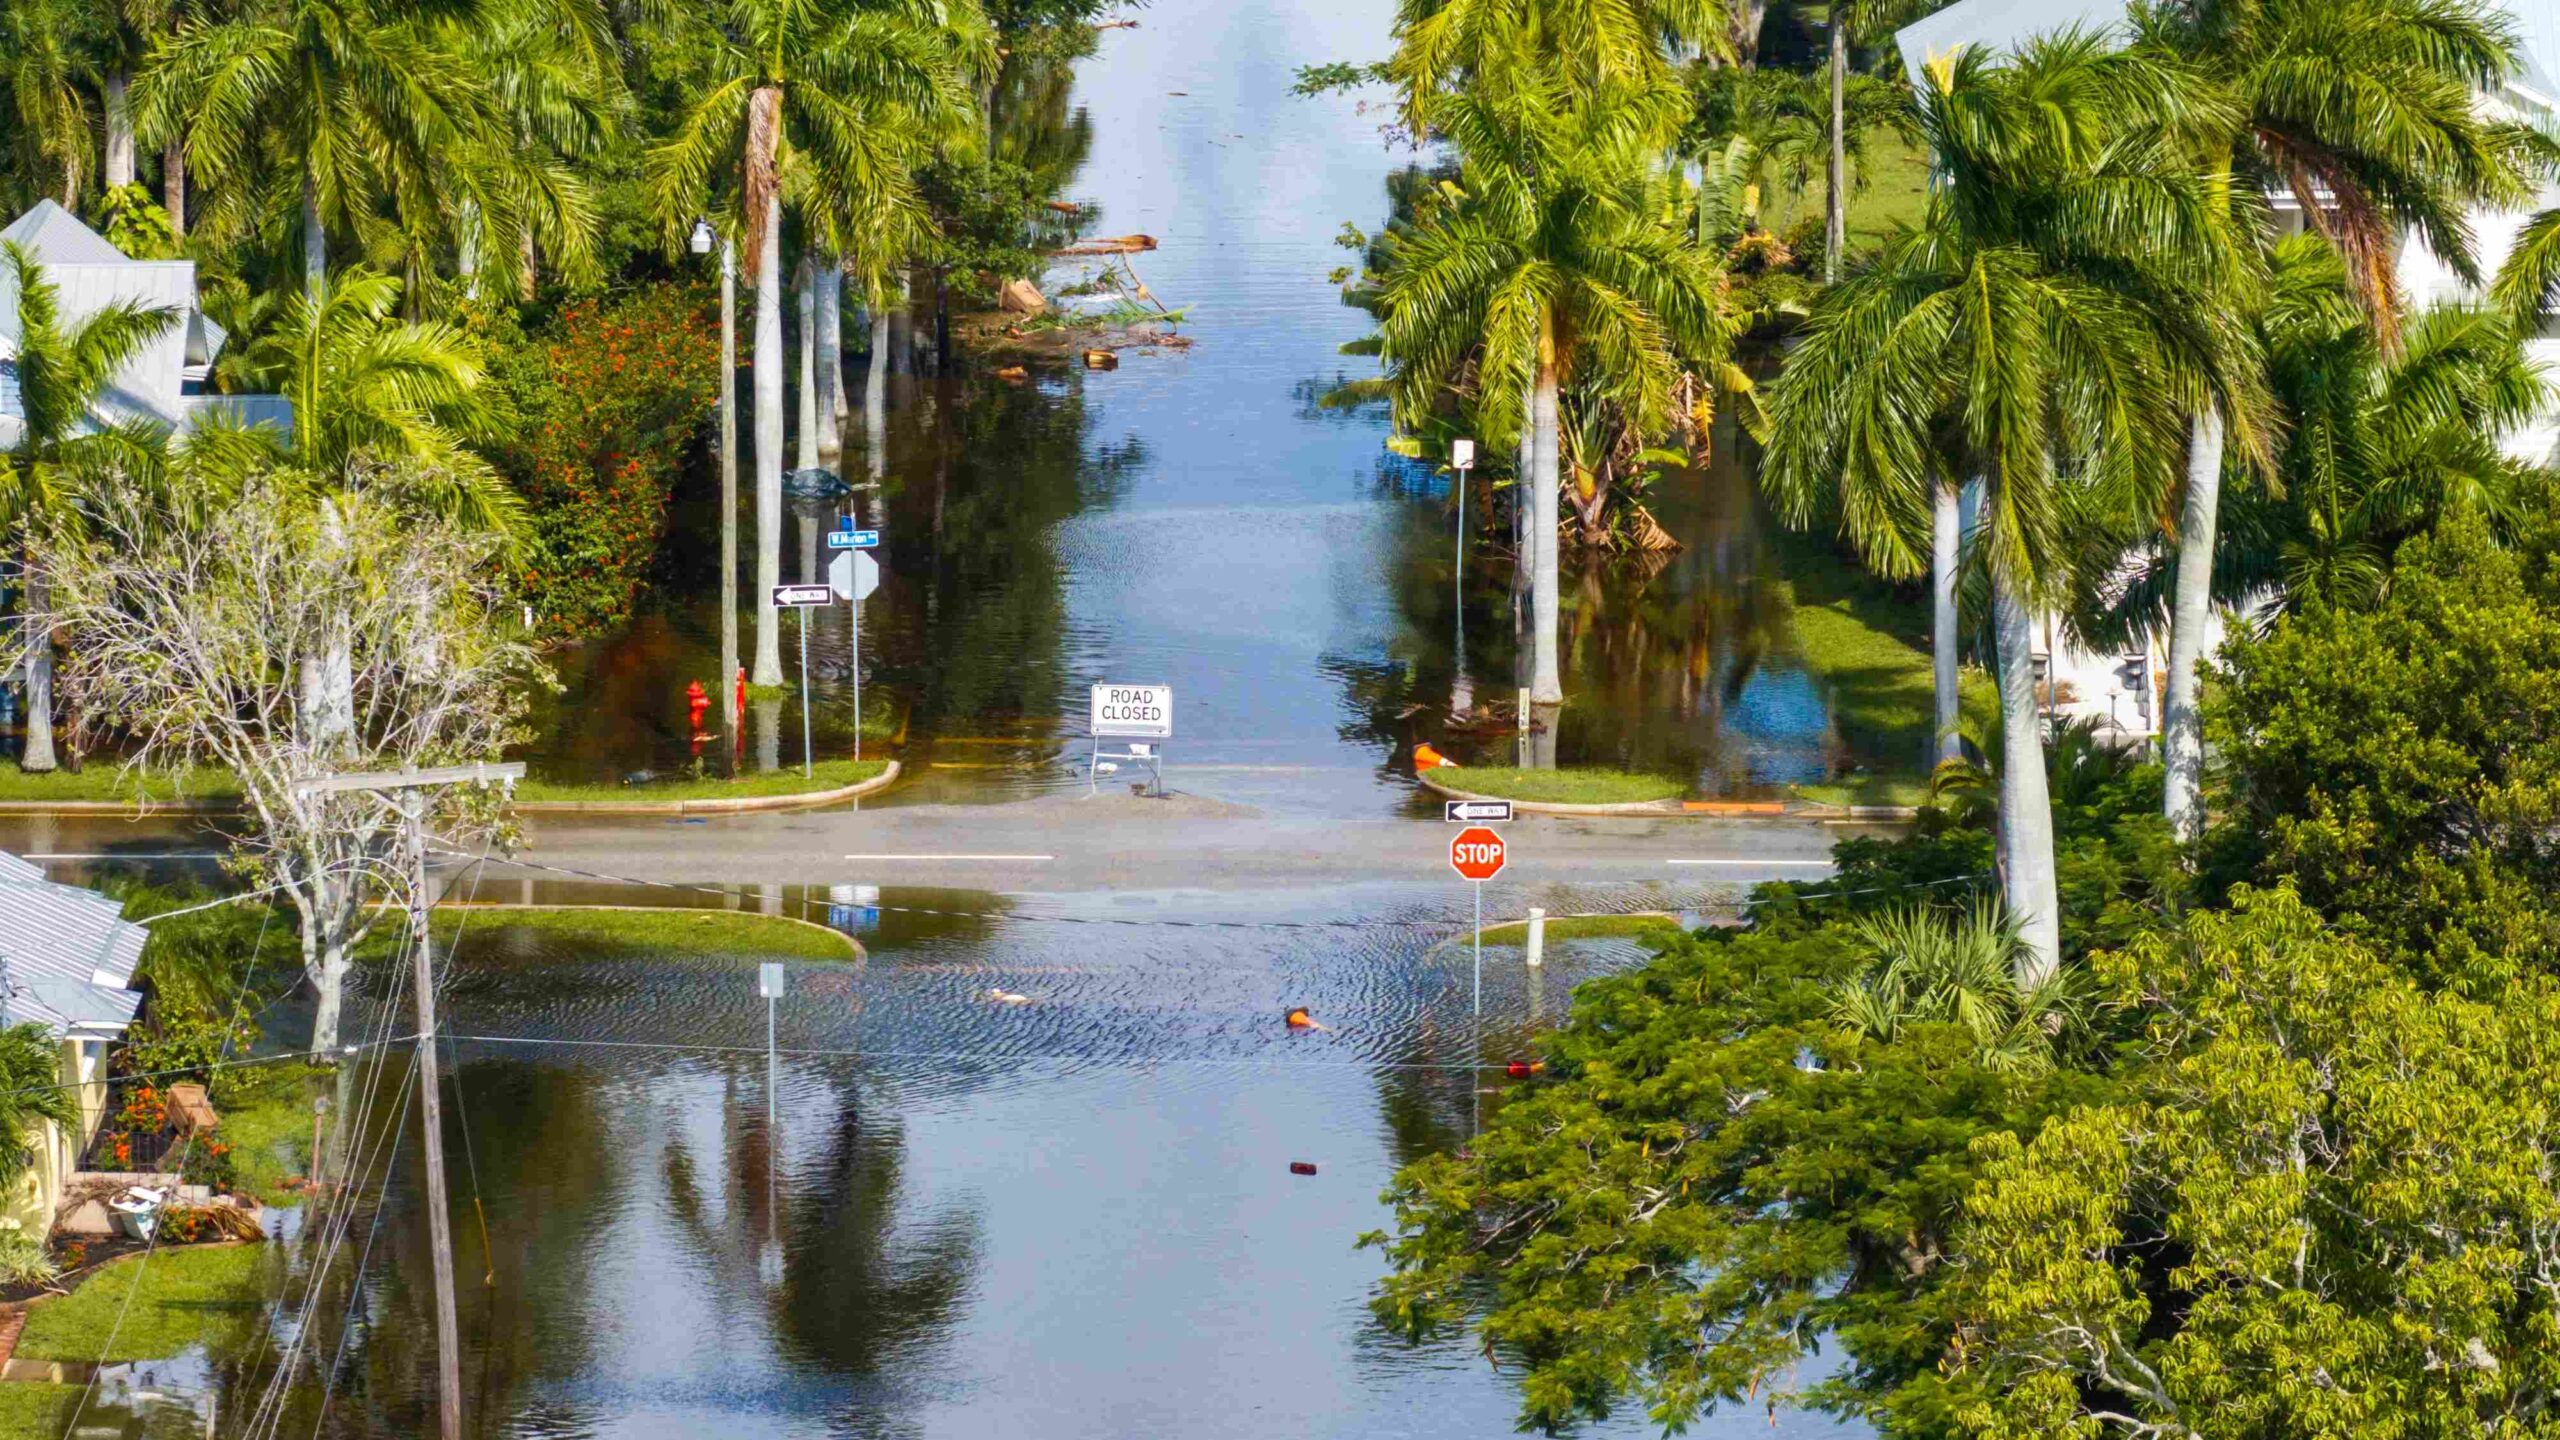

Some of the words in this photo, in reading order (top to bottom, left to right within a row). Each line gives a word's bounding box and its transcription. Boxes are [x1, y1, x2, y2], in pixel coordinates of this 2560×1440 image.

[1110, 689, 1153, 704] ROAD
[1102, 705, 1161, 721] CLOSED
[1467, 807, 1483, 815] ONE
[1487, 807, 1504, 815] WAY
[1454, 843, 1502, 864] STOP
